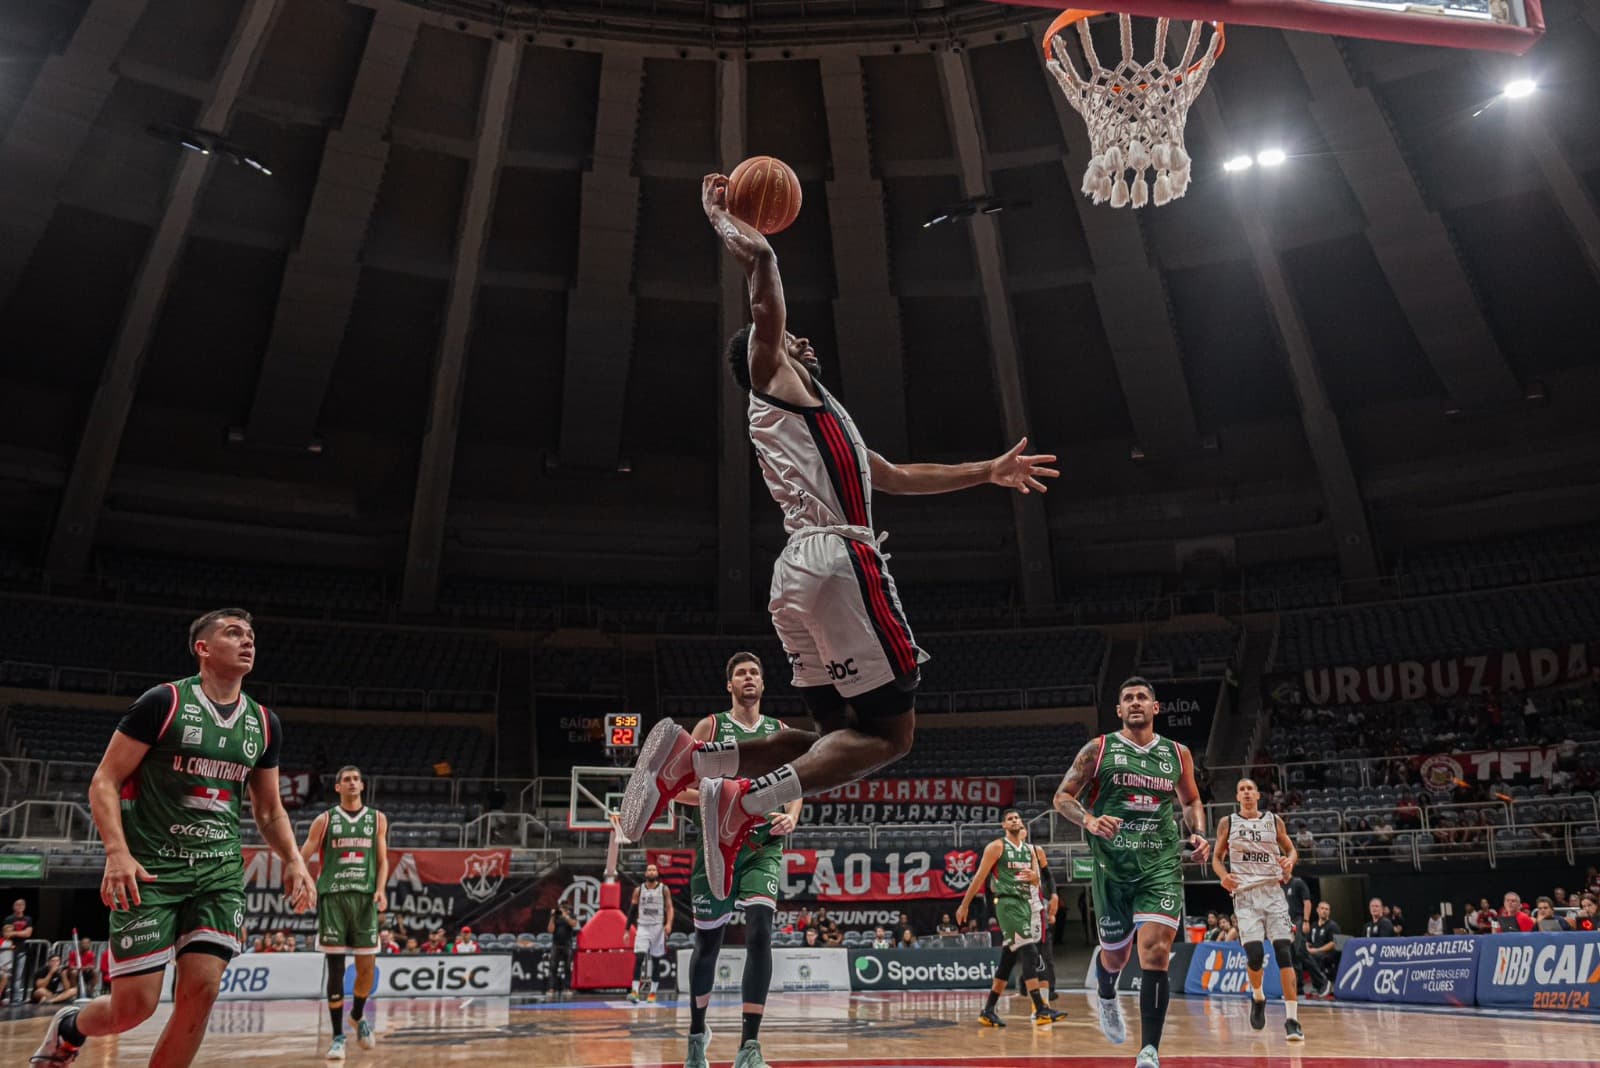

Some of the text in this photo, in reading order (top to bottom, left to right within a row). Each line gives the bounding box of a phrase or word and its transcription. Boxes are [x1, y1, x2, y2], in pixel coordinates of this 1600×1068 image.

[1304, 643, 1589, 705] URUBUZADA
[560, 715, 601, 729] SAÍDA
[615, 716, 637, 726] 5:35
[1167, 714, 1192, 727] Exit
[568, 732, 592, 743] Exit
[612, 728, 633, 744] 22
[206, 788, 220, 808] 7
[868, 780, 1001, 802] FLAMENGO
[820, 803, 876, 822] PELO
[882, 803, 1000, 822] FLAMENGO
[885, 851, 931, 894] 12
[1380, 939, 1475, 960] FORMAÇÃO DE ATLETAS
[887, 960, 998, 985] Sportsbet.i
[1492, 945, 1534, 986] NBB
[389, 960, 491, 992] ceisc
[1374, 968, 1404, 995] CBC
[1532, 991, 1591, 1009] 2023/24
